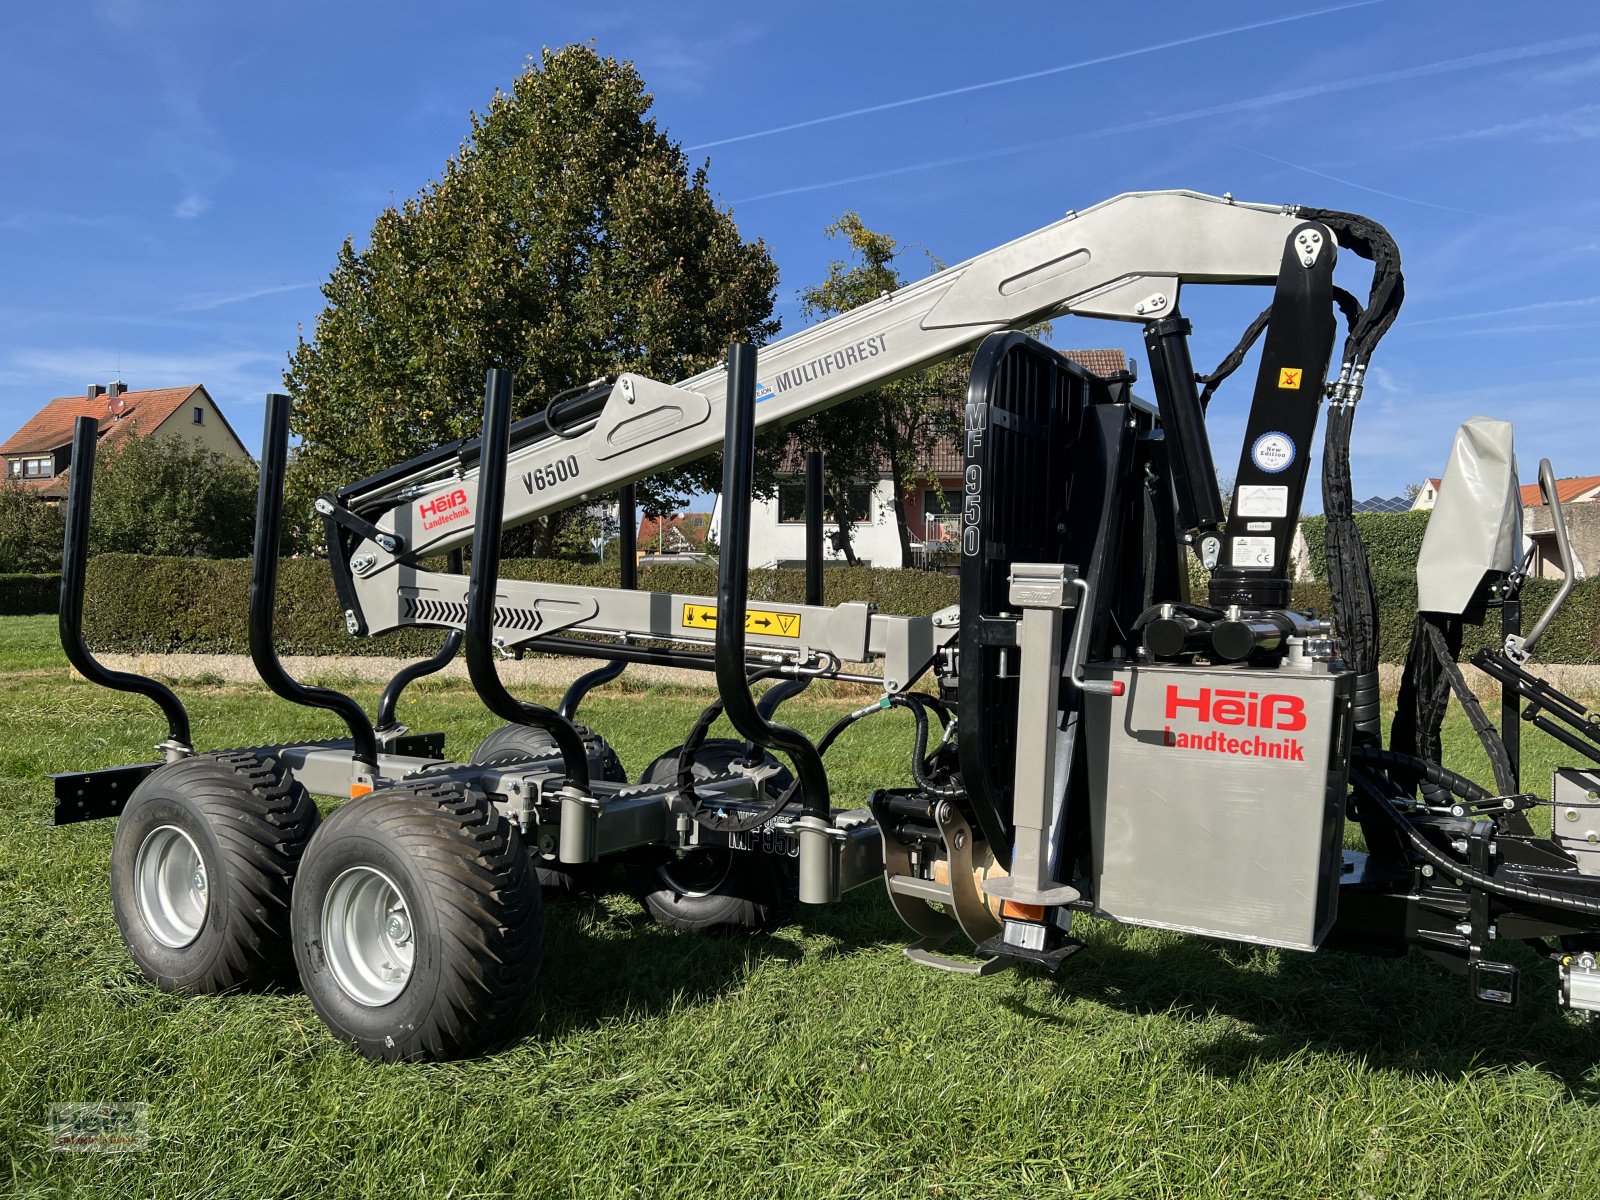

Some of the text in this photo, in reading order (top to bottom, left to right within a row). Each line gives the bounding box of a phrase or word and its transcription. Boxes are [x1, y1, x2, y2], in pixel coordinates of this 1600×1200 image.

[775, 333, 887, 392] MULTIFOREST
[521, 454, 580, 495] V6500
[963, 403, 987, 556] MF 950
[423, 507, 470, 531] Landtechnik
[1164, 726, 1305, 761] Landtechnik
